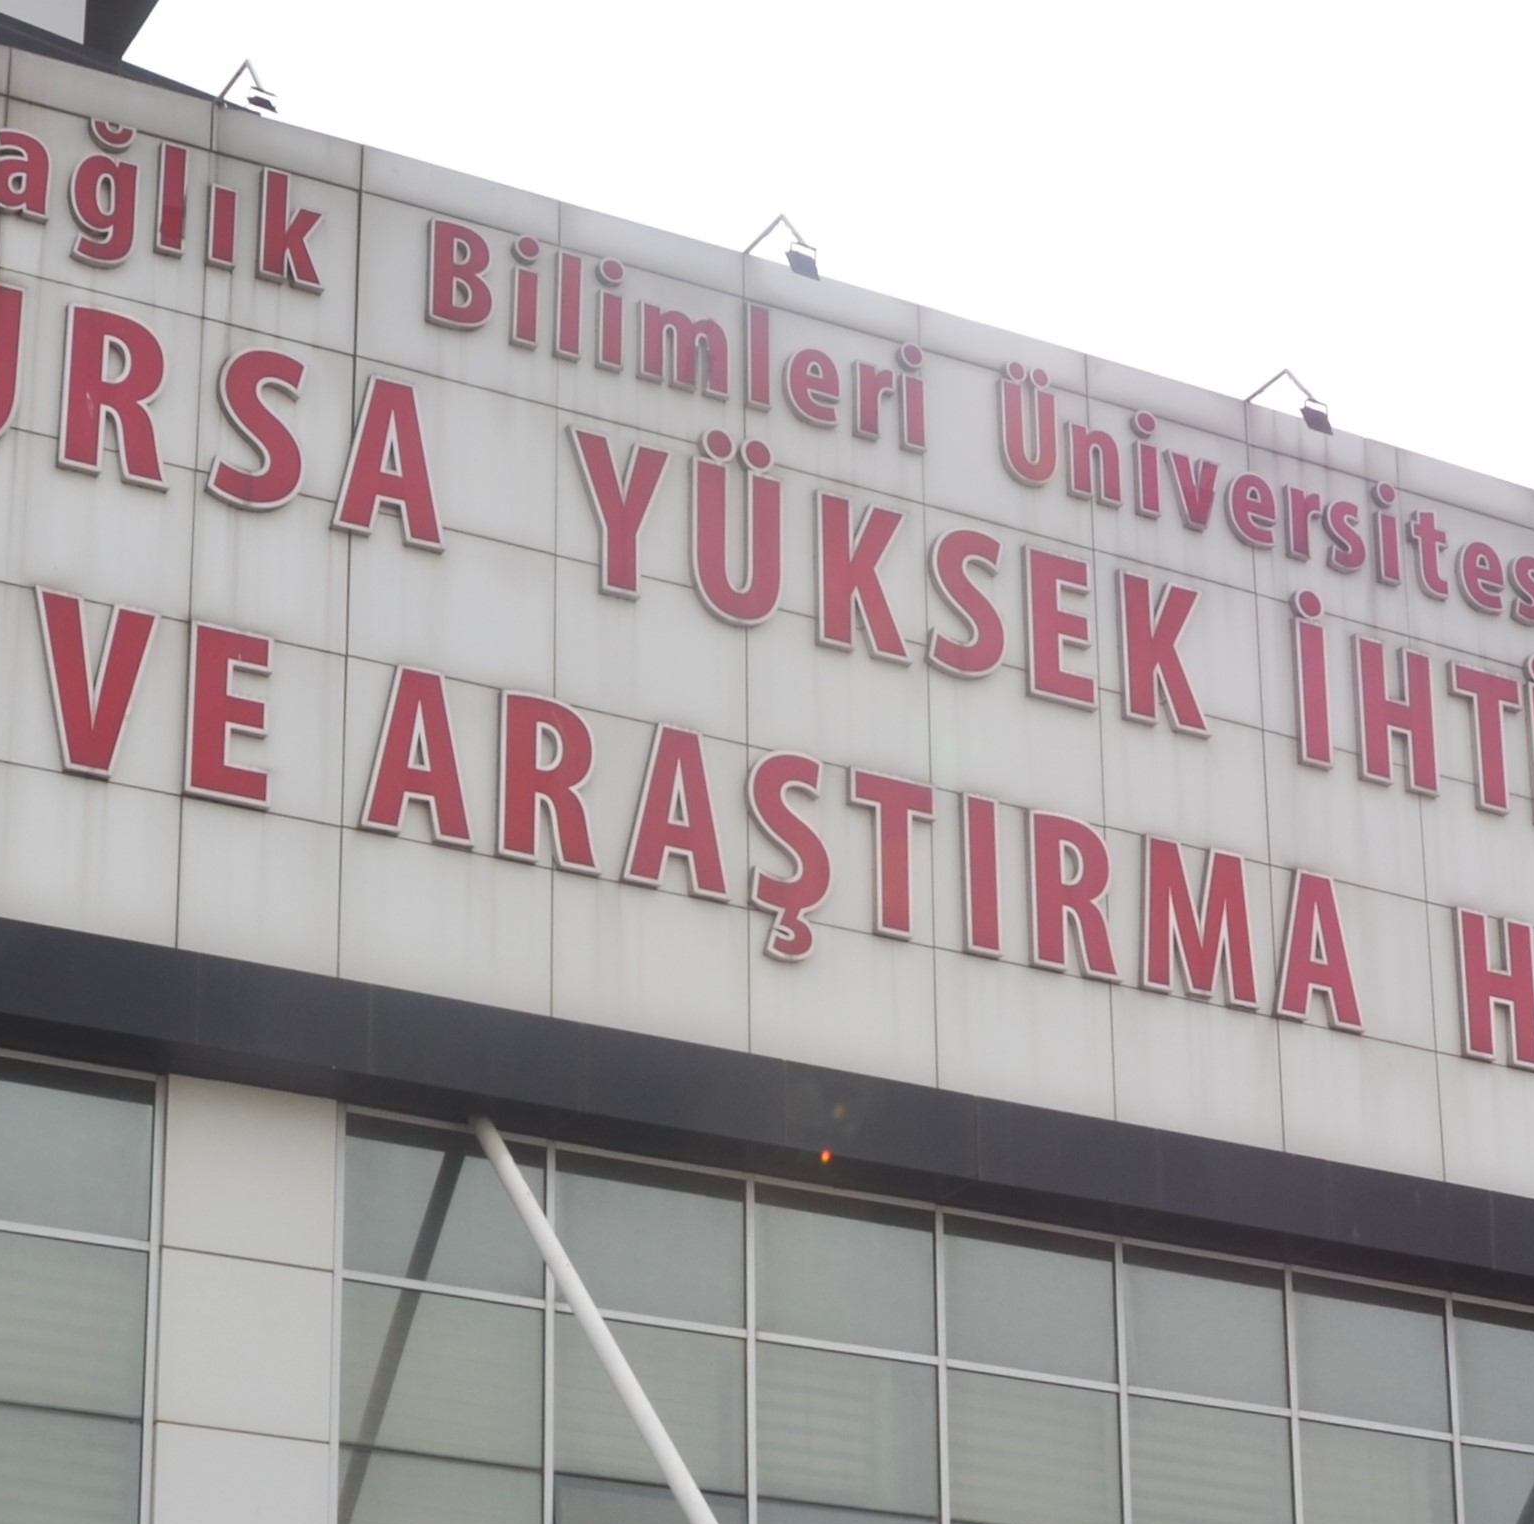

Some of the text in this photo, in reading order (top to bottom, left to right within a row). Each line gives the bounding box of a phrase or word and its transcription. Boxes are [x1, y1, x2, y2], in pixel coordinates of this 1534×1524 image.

[426, 218, 927, 452] Bilimleri
[569, 425, 1211, 738] YÜKSEK
[35, 585, 272, 809] VE
[361, 664, 1365, 1034] ARAŞTIRMA
